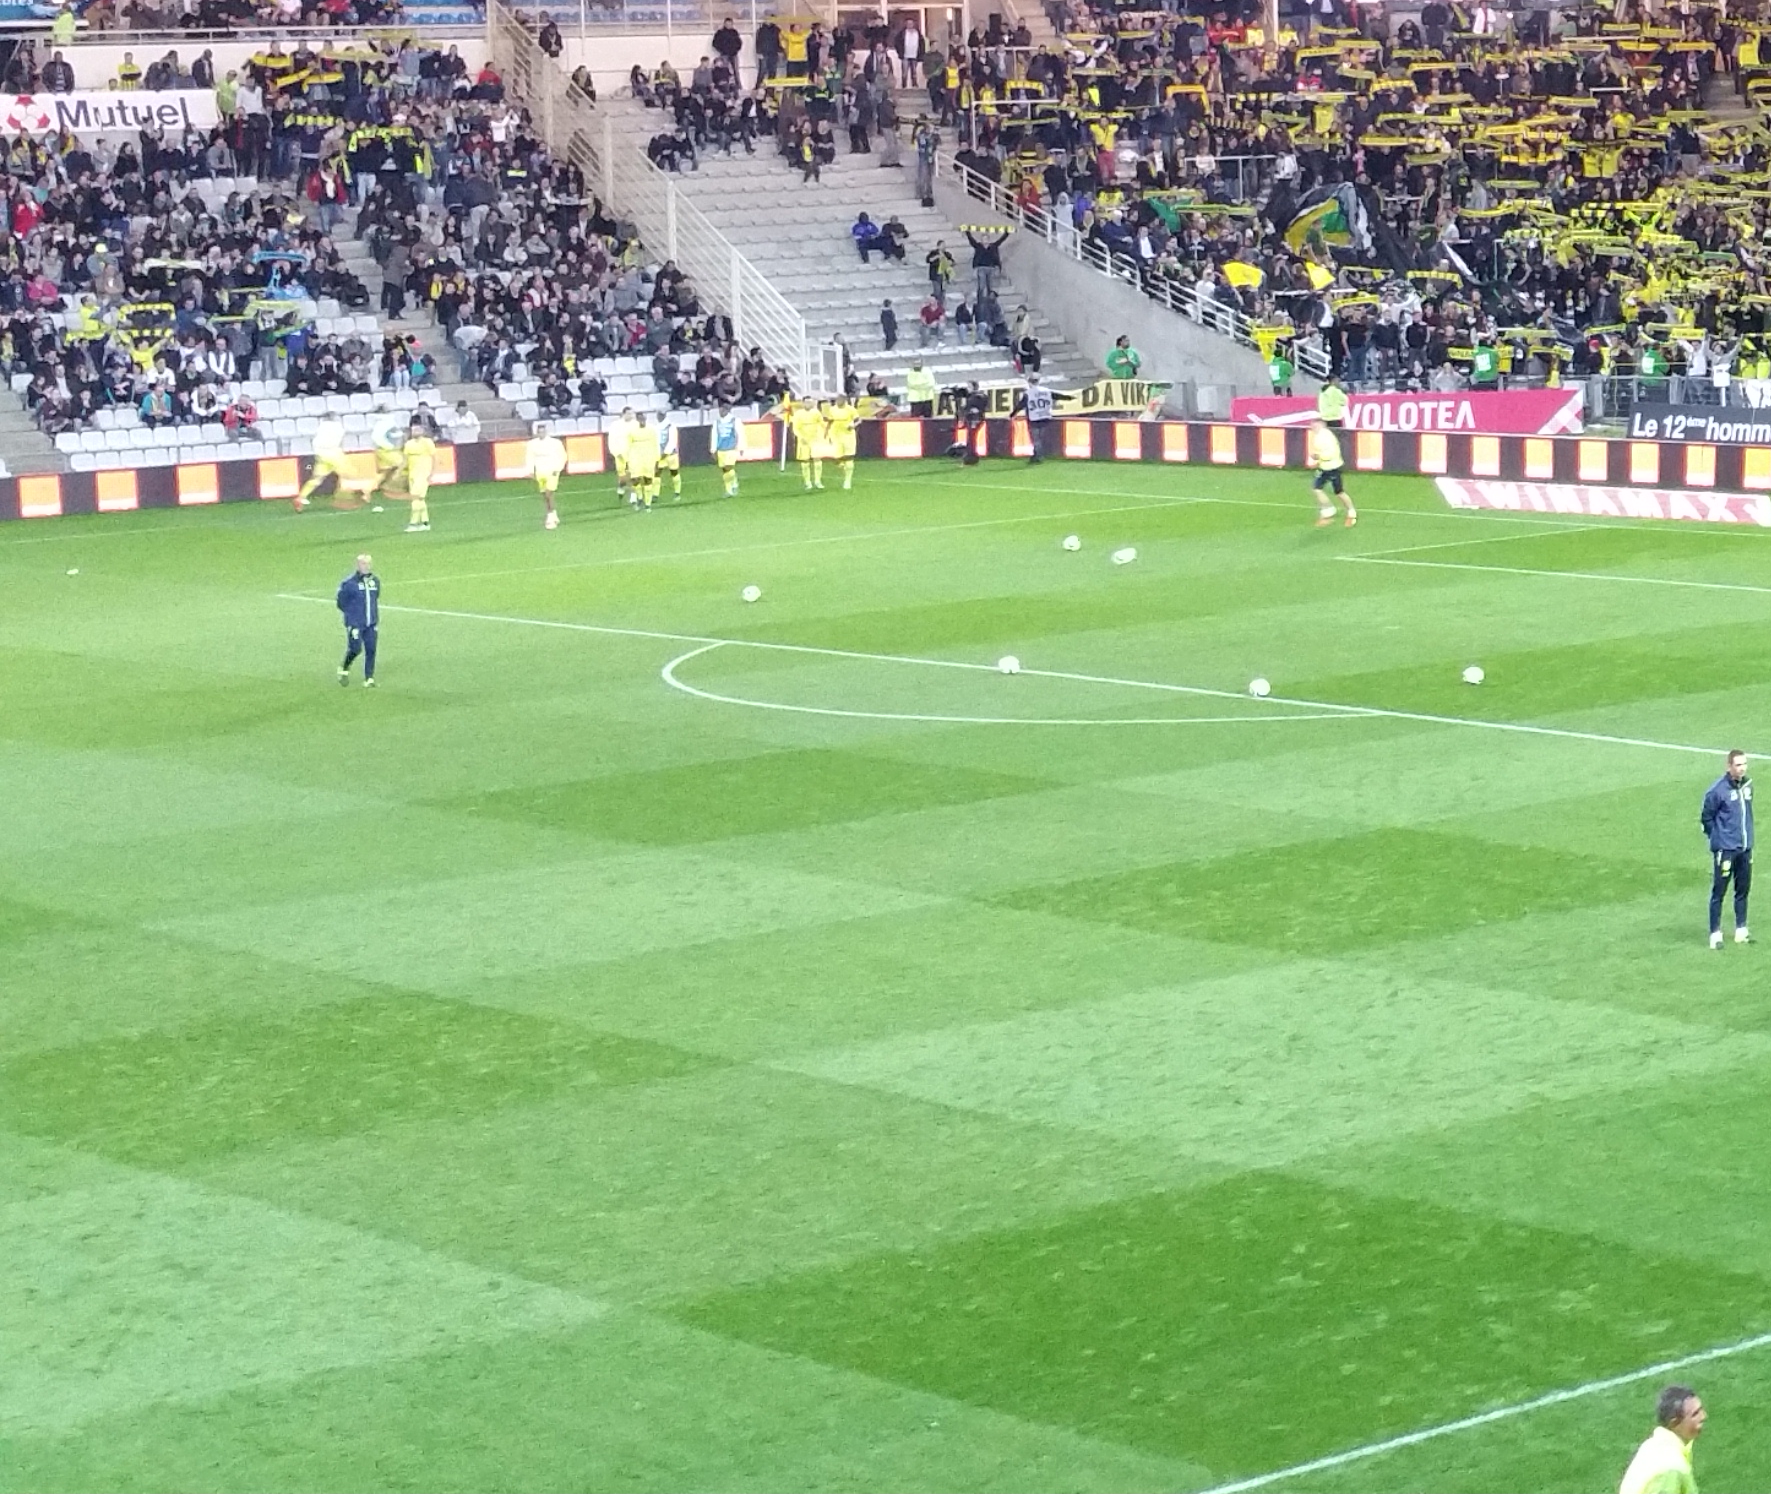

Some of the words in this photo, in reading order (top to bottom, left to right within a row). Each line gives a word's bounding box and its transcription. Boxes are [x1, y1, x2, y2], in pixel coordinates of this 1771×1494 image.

[55, 97, 189, 128] Mutuel
[1341, 400, 1476, 431] VOLOTEA
[1633, 413, 1657, 438] Le
